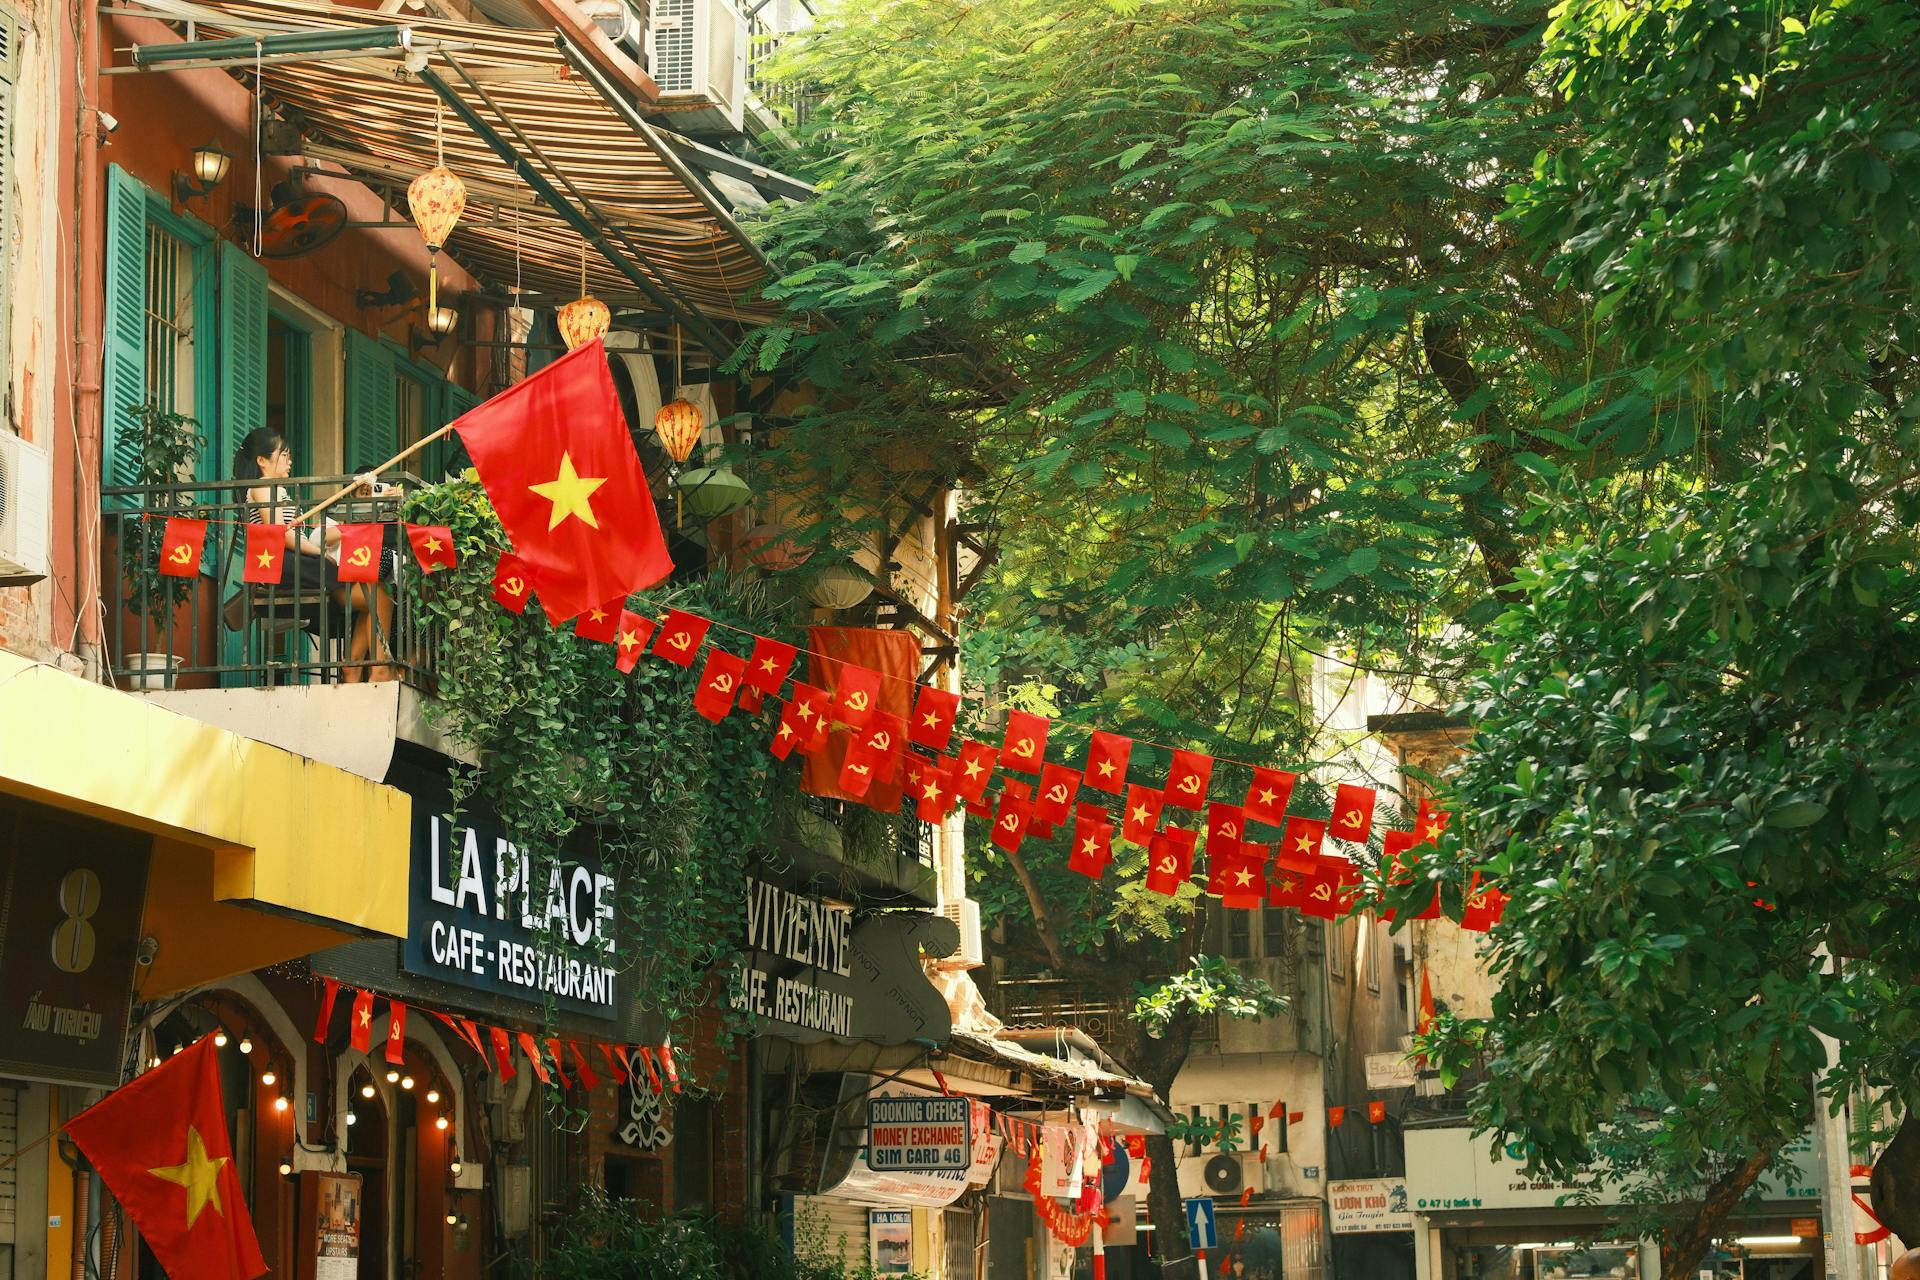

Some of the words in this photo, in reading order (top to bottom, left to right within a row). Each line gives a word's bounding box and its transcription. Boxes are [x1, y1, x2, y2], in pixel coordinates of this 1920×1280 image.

[430, 815, 487, 916] LA
[496, 837, 616, 954] PLACE
[51, 868, 101, 973] 8
[745, 876, 852, 977] VIVIENNE
[431, 920, 485, 975] CAFE
[498, 940, 616, 1006] RESTAURANT
[775, 977, 853, 1036] RESTAURANT
[872, 1102, 922, 1123] BOOKING
[926, 1101, 964, 1122] OFFICE
[873, 1127, 909, 1147] MONEY
[912, 1126, 964, 1145] EXCHANGE
[876, 1149, 902, 1165] SIM
[906, 1149, 939, 1164] CARD
[944, 1148, 961, 1164] 4G
[323, 1233, 337, 1243] MORE
[337, 1234, 352, 1244] SEATS
[325, 1247, 348, 1257] UPSTAIRS
